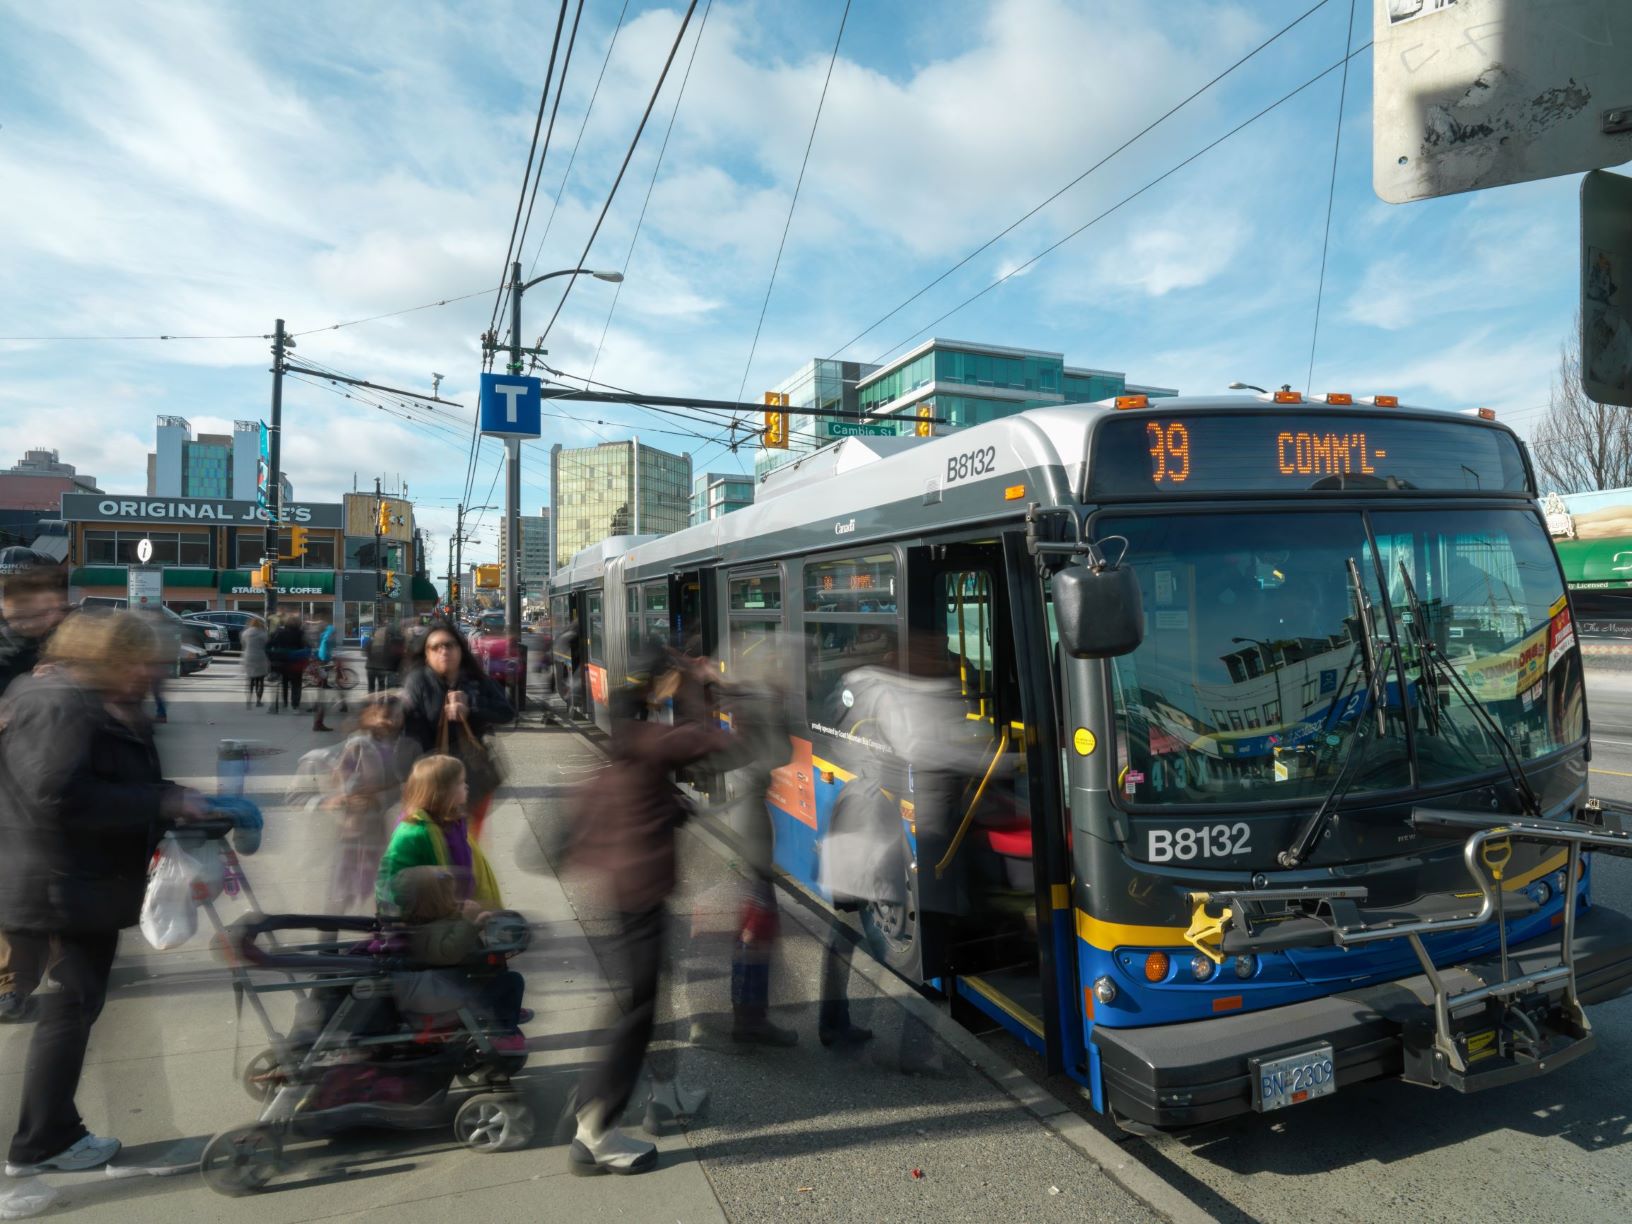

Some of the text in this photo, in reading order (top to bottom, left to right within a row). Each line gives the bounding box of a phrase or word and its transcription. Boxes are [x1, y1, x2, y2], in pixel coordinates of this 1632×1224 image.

[495, 384, 528, 423] T
[833, 424, 892, 437] Cambie St
[947, 446, 996, 482] B8132
[1147, 422, 1189, 482] 39
[98, 500, 233, 520] ORIGINAL
[835, 518, 855, 535] Canada
[1148, 822, 1251, 862] B8132
[1291, 1060, 1332, 1091] 2309
